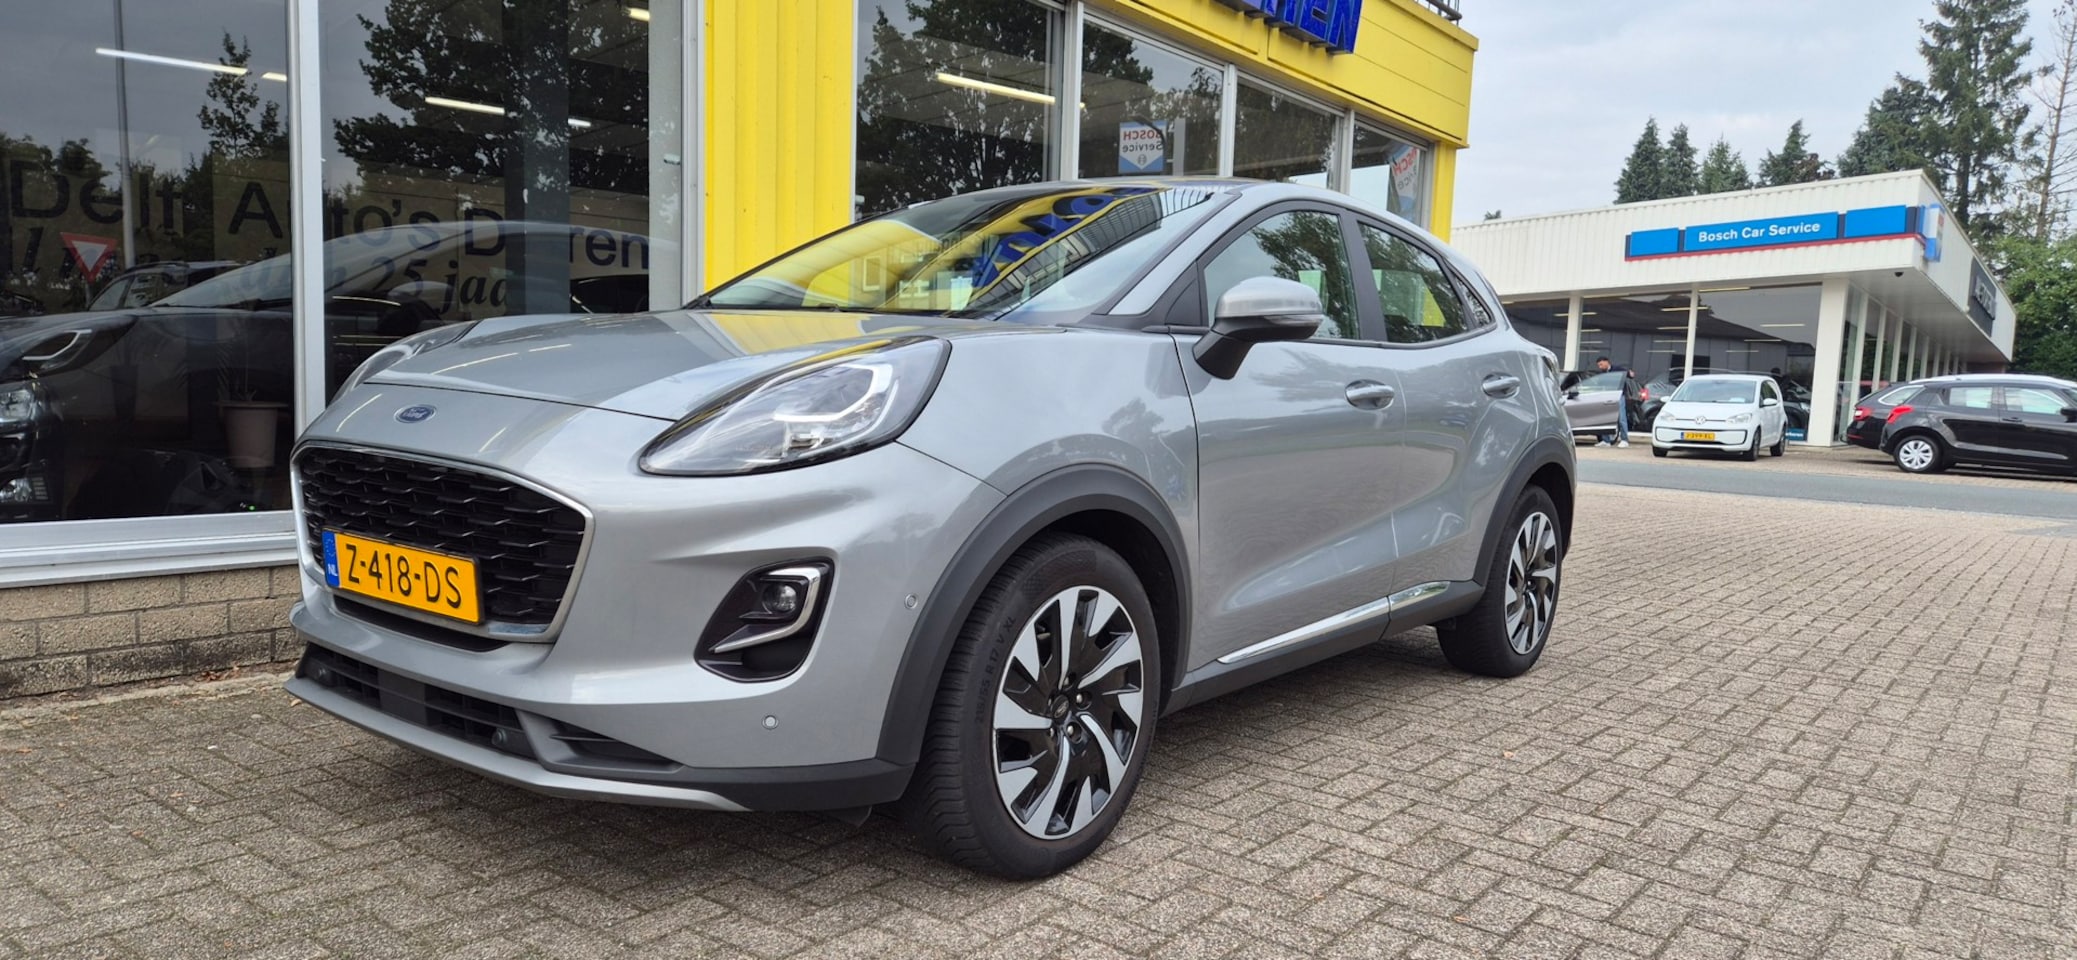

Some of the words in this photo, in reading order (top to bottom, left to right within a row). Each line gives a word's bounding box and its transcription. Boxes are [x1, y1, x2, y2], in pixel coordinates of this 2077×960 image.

[1698, 229, 1738, 242] Bosch
[1741, 226, 1766, 239] Car
[1768, 221, 1820, 236] Service
[328, 564, 338, 577] NL
[346, 543, 462, 608] Z-418-DS
